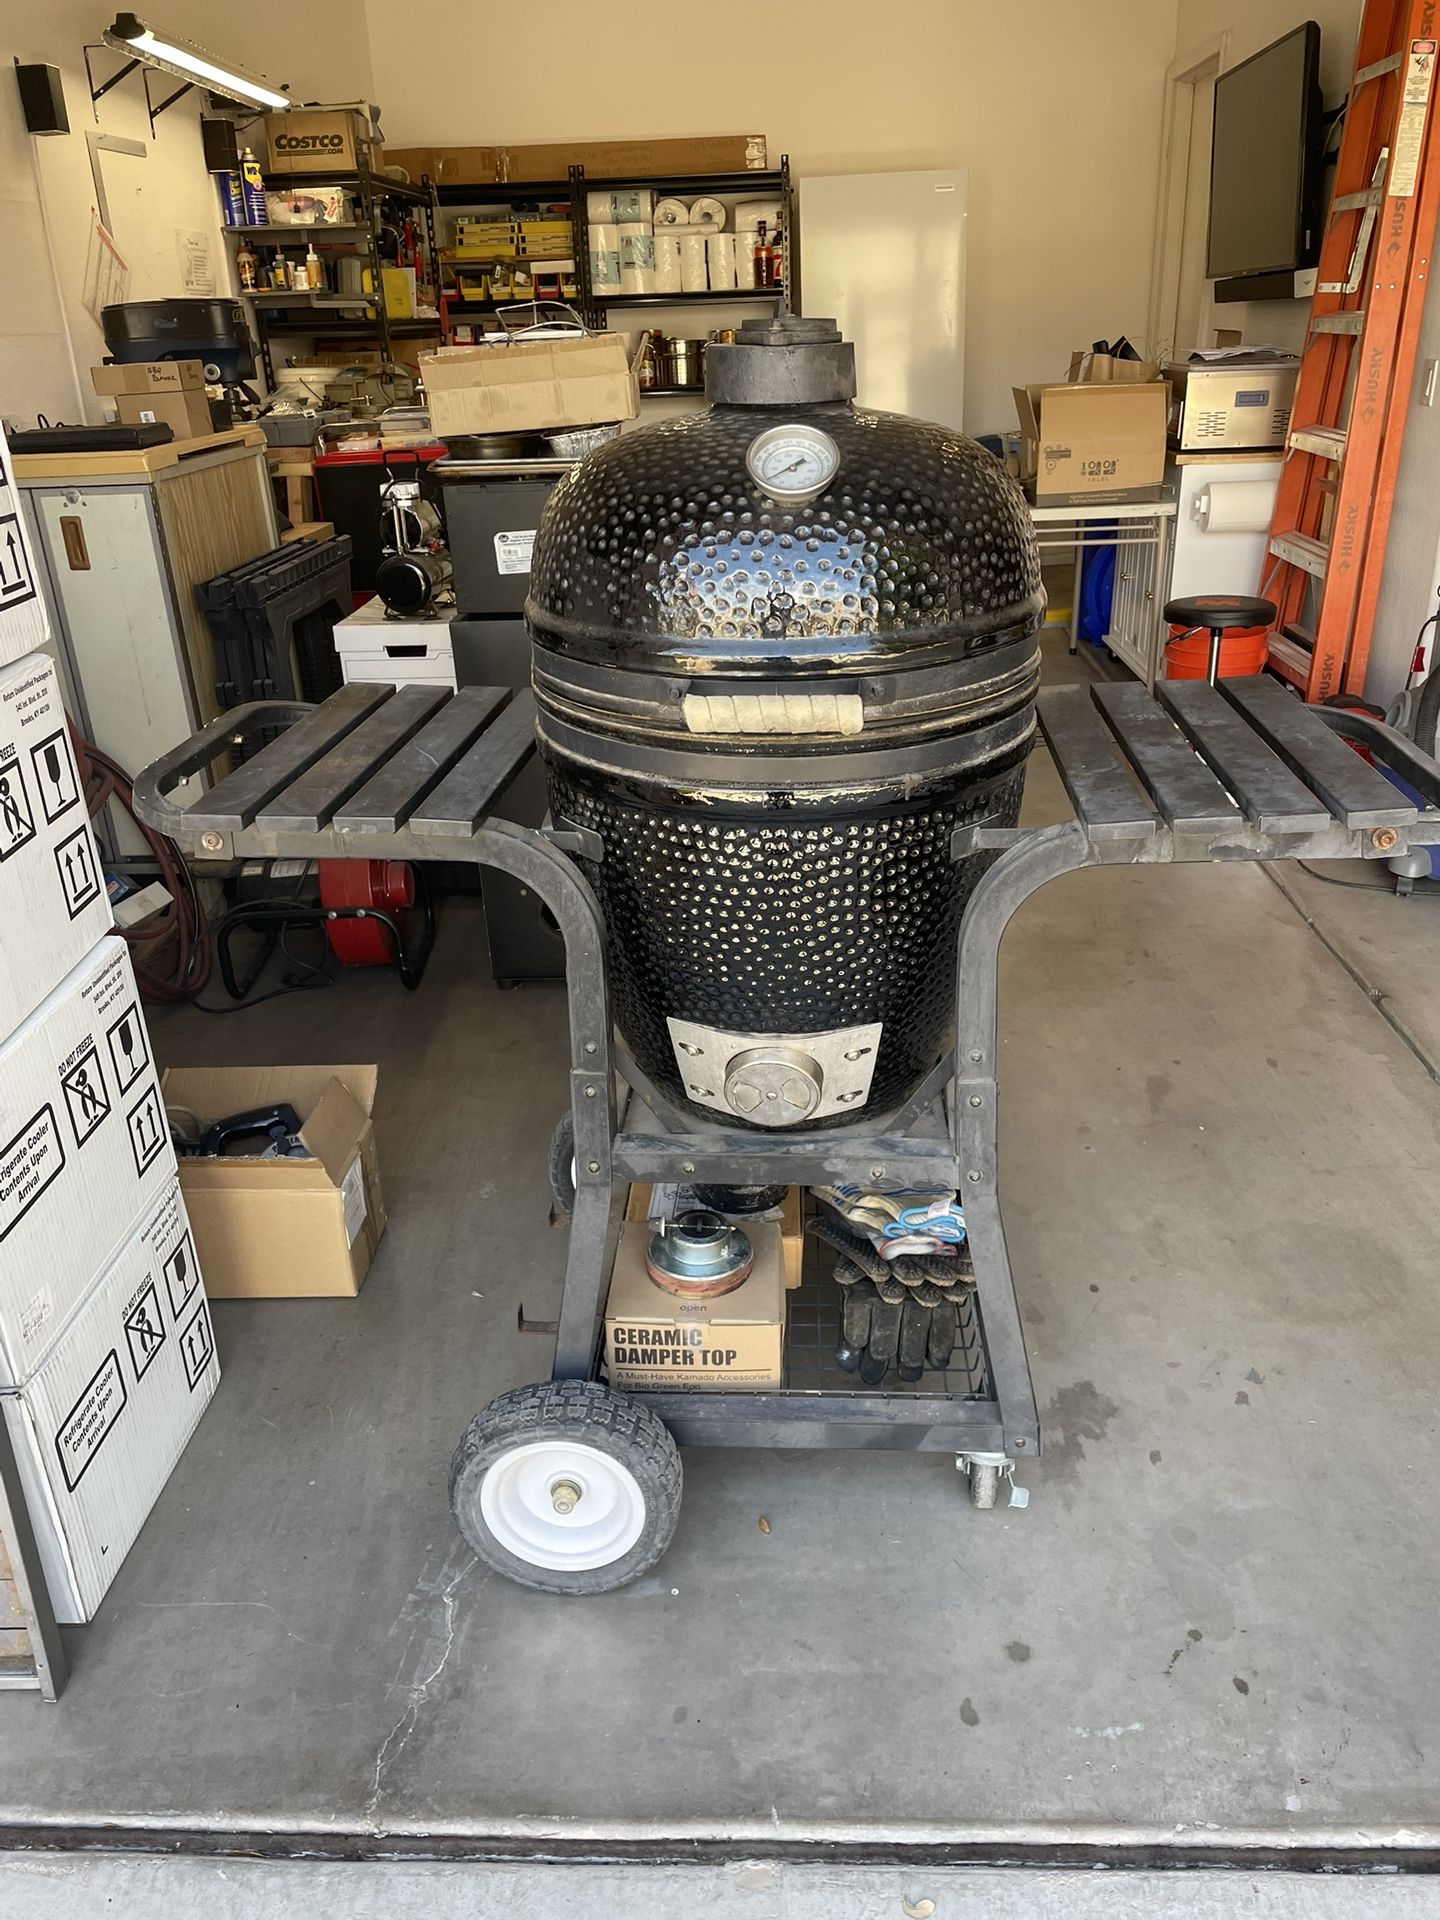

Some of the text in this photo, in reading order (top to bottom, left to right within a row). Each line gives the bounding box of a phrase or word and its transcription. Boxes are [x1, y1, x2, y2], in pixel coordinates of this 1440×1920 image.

[1421, 0, 1436, 40] SKY
[275, 134, 344, 150] COSTCO
[1391, 196, 1407, 237] HUS
[1366, 346, 1382, 402] HUSKY
[1341, 504, 1358, 556] HUSKY
[0, 742, 16, 762] REEZE
[58, 1033, 94, 1077] DO NOT FREEZE
[0, 1122, 48, 1183] rigerate Cooler
[0, 1144, 48, 1202] Contents Upon
[18, 1171, 40, 1203] Arrival
[122, 1271, 152, 1321] DO NOT FREEZE
[680, 1305, 707, 1313] open
[614, 1328, 702, 1346] CERAMIC
[615, 1348, 736, 1366] DAMPER TOP
[626, 1373, 674, 1381] Must-Have
[652, 1382, 680, 1390] Green
[63, 1367, 114, 1448] Refrigerate Cooler
[72, 1388, 112, 1452] Contents Upon
[87, 1416, 106, 1450] Arrival
